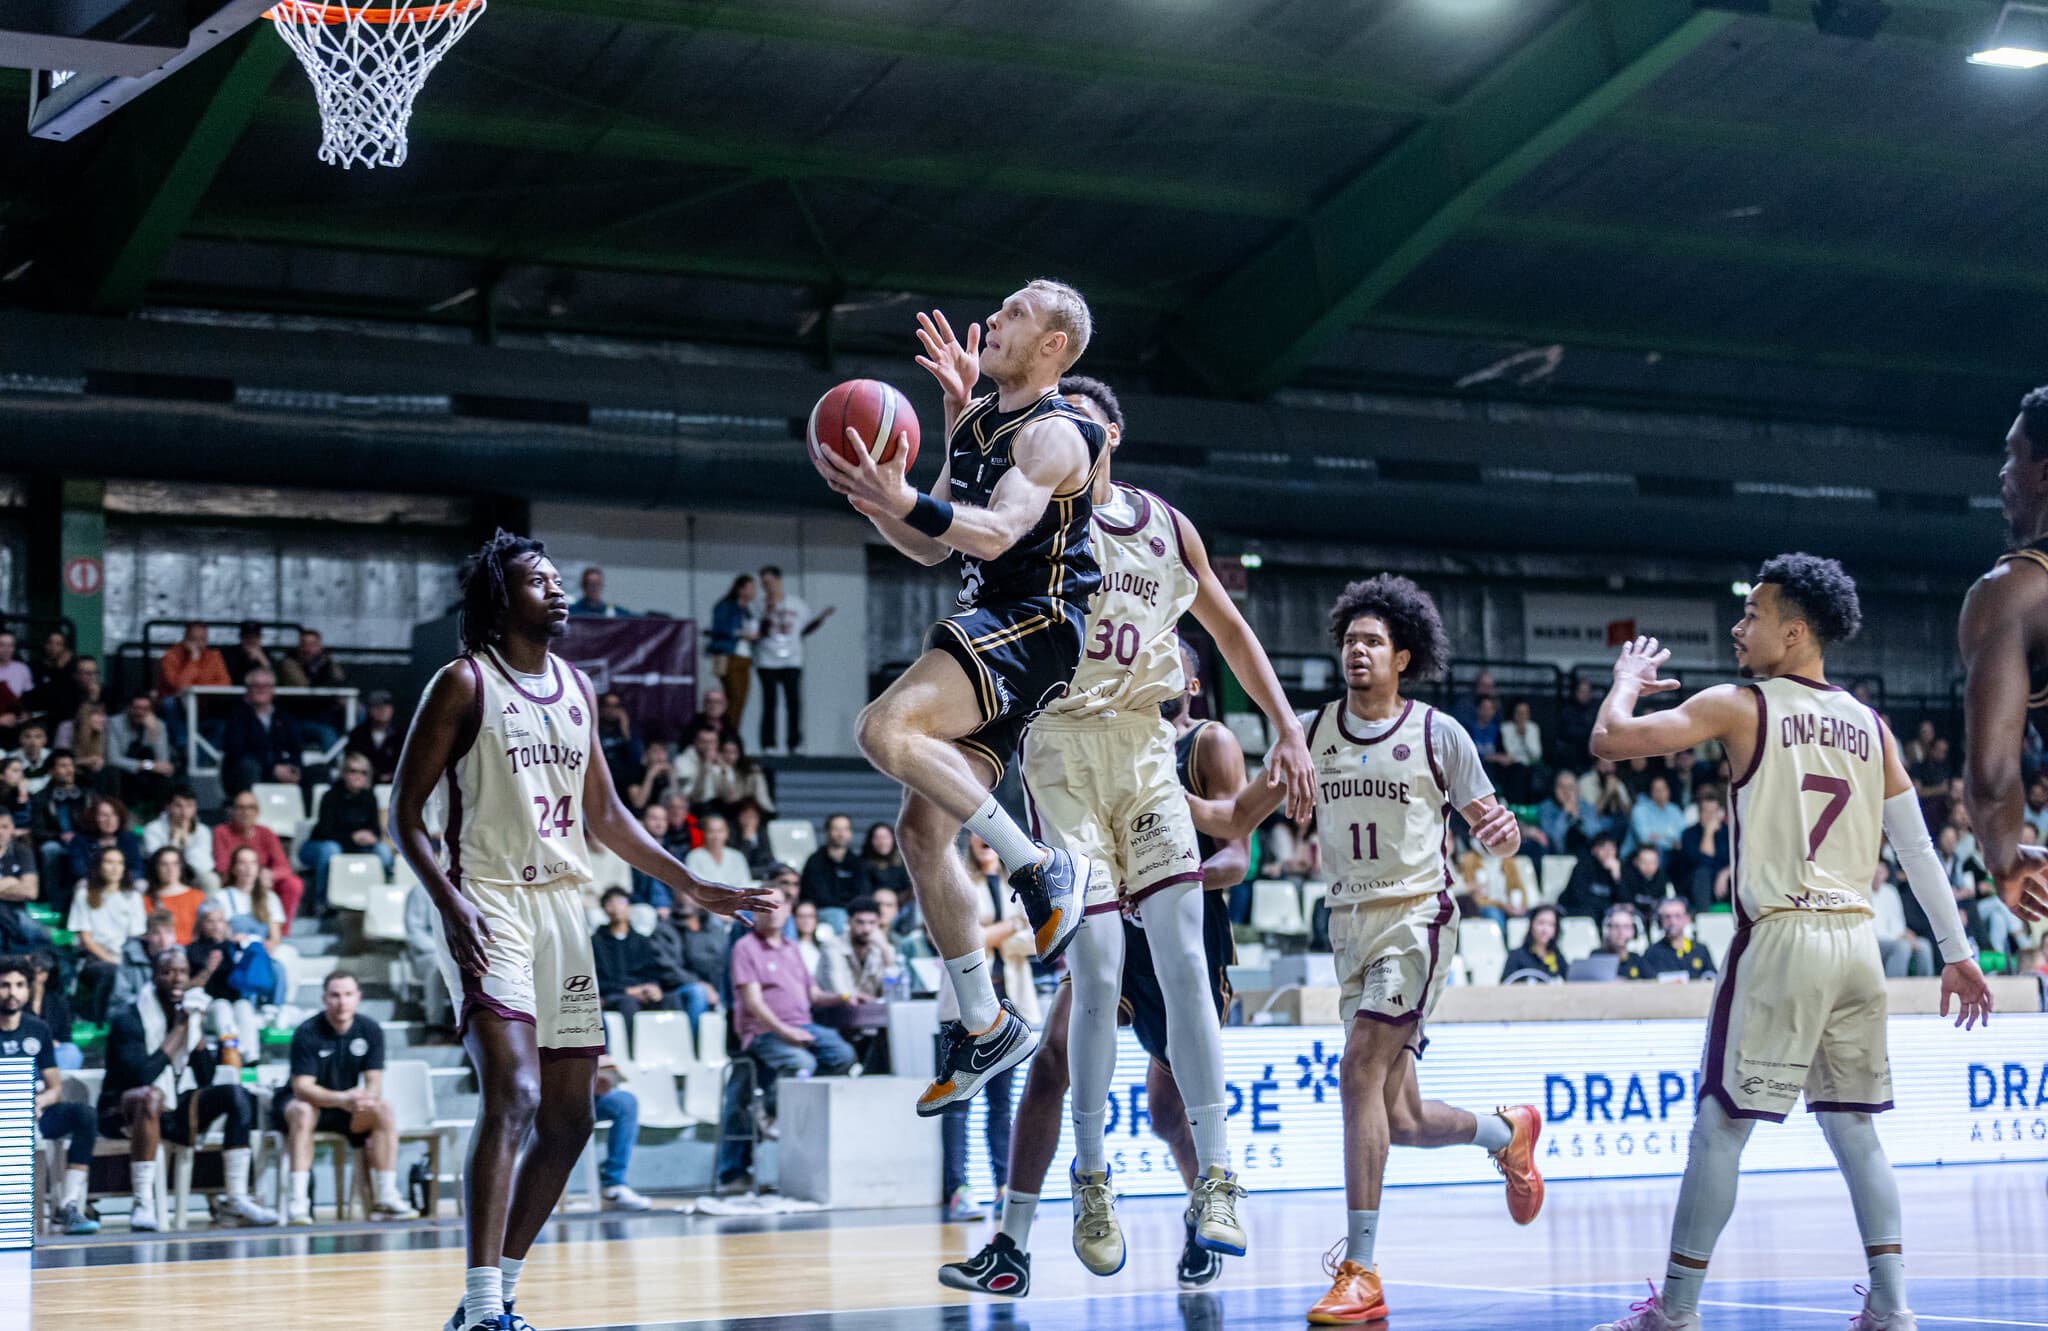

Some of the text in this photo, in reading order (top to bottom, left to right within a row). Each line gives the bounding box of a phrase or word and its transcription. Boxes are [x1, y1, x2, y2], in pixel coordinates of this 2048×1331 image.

[1096, 571, 1160, 607] ULOUSE
[1086, 618, 1140, 666] 30
[1782, 714, 1869, 762] ONA EMBO
[1321, 778, 1410, 805] TOULOUSE
[533, 795, 575, 838] 24
[1130, 825, 1171, 847] HYUNDAI
[1801, 773, 1851, 862] 7
[1348, 822, 1379, 860] 11
[1137, 858, 1170, 877] autobuy
[1545, 1071, 1701, 1123] DRAP
